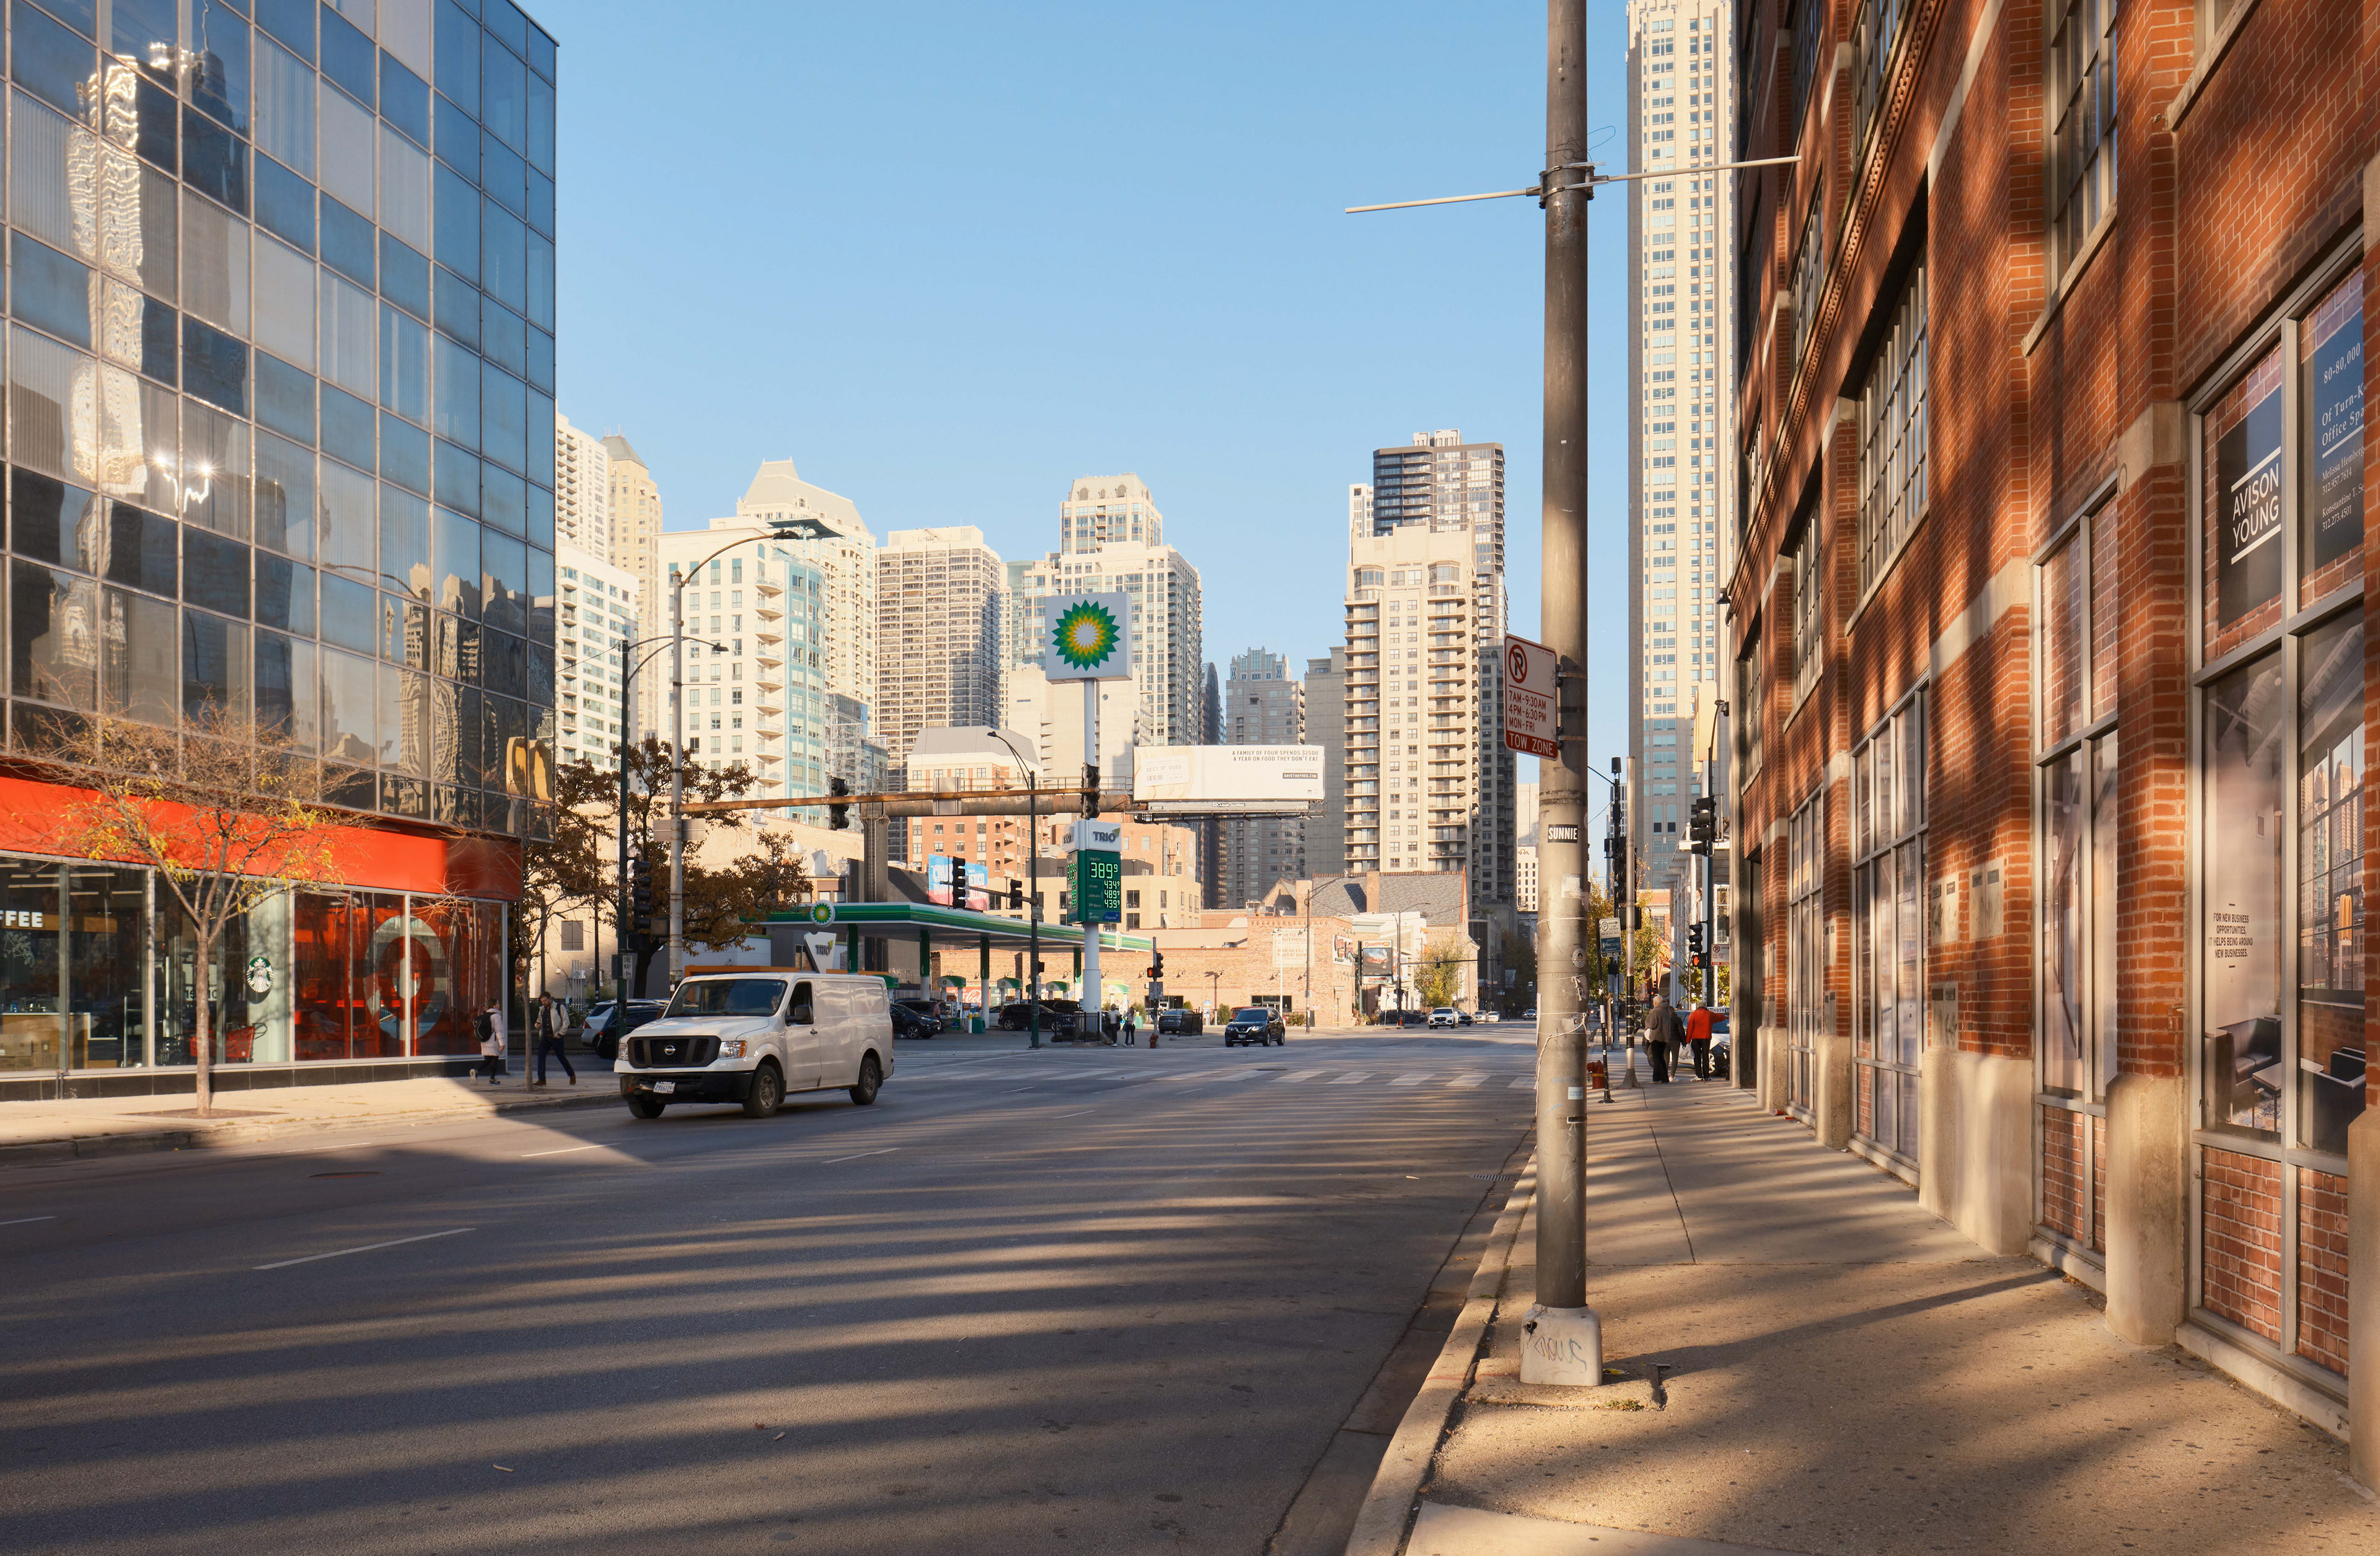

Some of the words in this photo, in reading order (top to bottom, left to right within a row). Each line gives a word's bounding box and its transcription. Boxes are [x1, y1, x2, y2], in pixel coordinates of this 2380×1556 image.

[2324, 343, 2360, 384] 80-80,000
[2322, 408, 2332, 426] Of
[2322, 420, 2347, 446] Office
[2322, 464, 2340, 482] Melissa
[2322, 467, 2352, 495] 312.957.7614
[2232, 463, 2278, 521] AVISON
[2322, 493, 2351, 518] Konstantine
[2351, 487, 2358, 497] T.
[2232, 495, 2278, 548] YOUNG
[2322, 504, 2351, 532] 312.273.4501
[1509, 733, 1527, 750] TOW
[1532, 739, 1553, 756] ZONE
[1093, 831, 1116, 842] TRIO
[1548, 827, 1577, 840] SUNNIE
[2213, 913, 2221, 921] FOR
[2223, 913, 2231, 922] NEW
[2232, 914, 2249, 923] BUSINESS
[2216, 925, 2246, 935] OPPORTUNITIES,
[816, 944, 831, 956] TRIO
[2208, 938, 2212, 946] IT
[2213, 938, 2226, 946] HELPS
[2227, 938, 2238, 946] BEING
[2239, 938, 2253, 946] AROUND
[2215, 949, 2224, 958] NEW
[2224, 949, 2247, 957] BUSINESSES.
